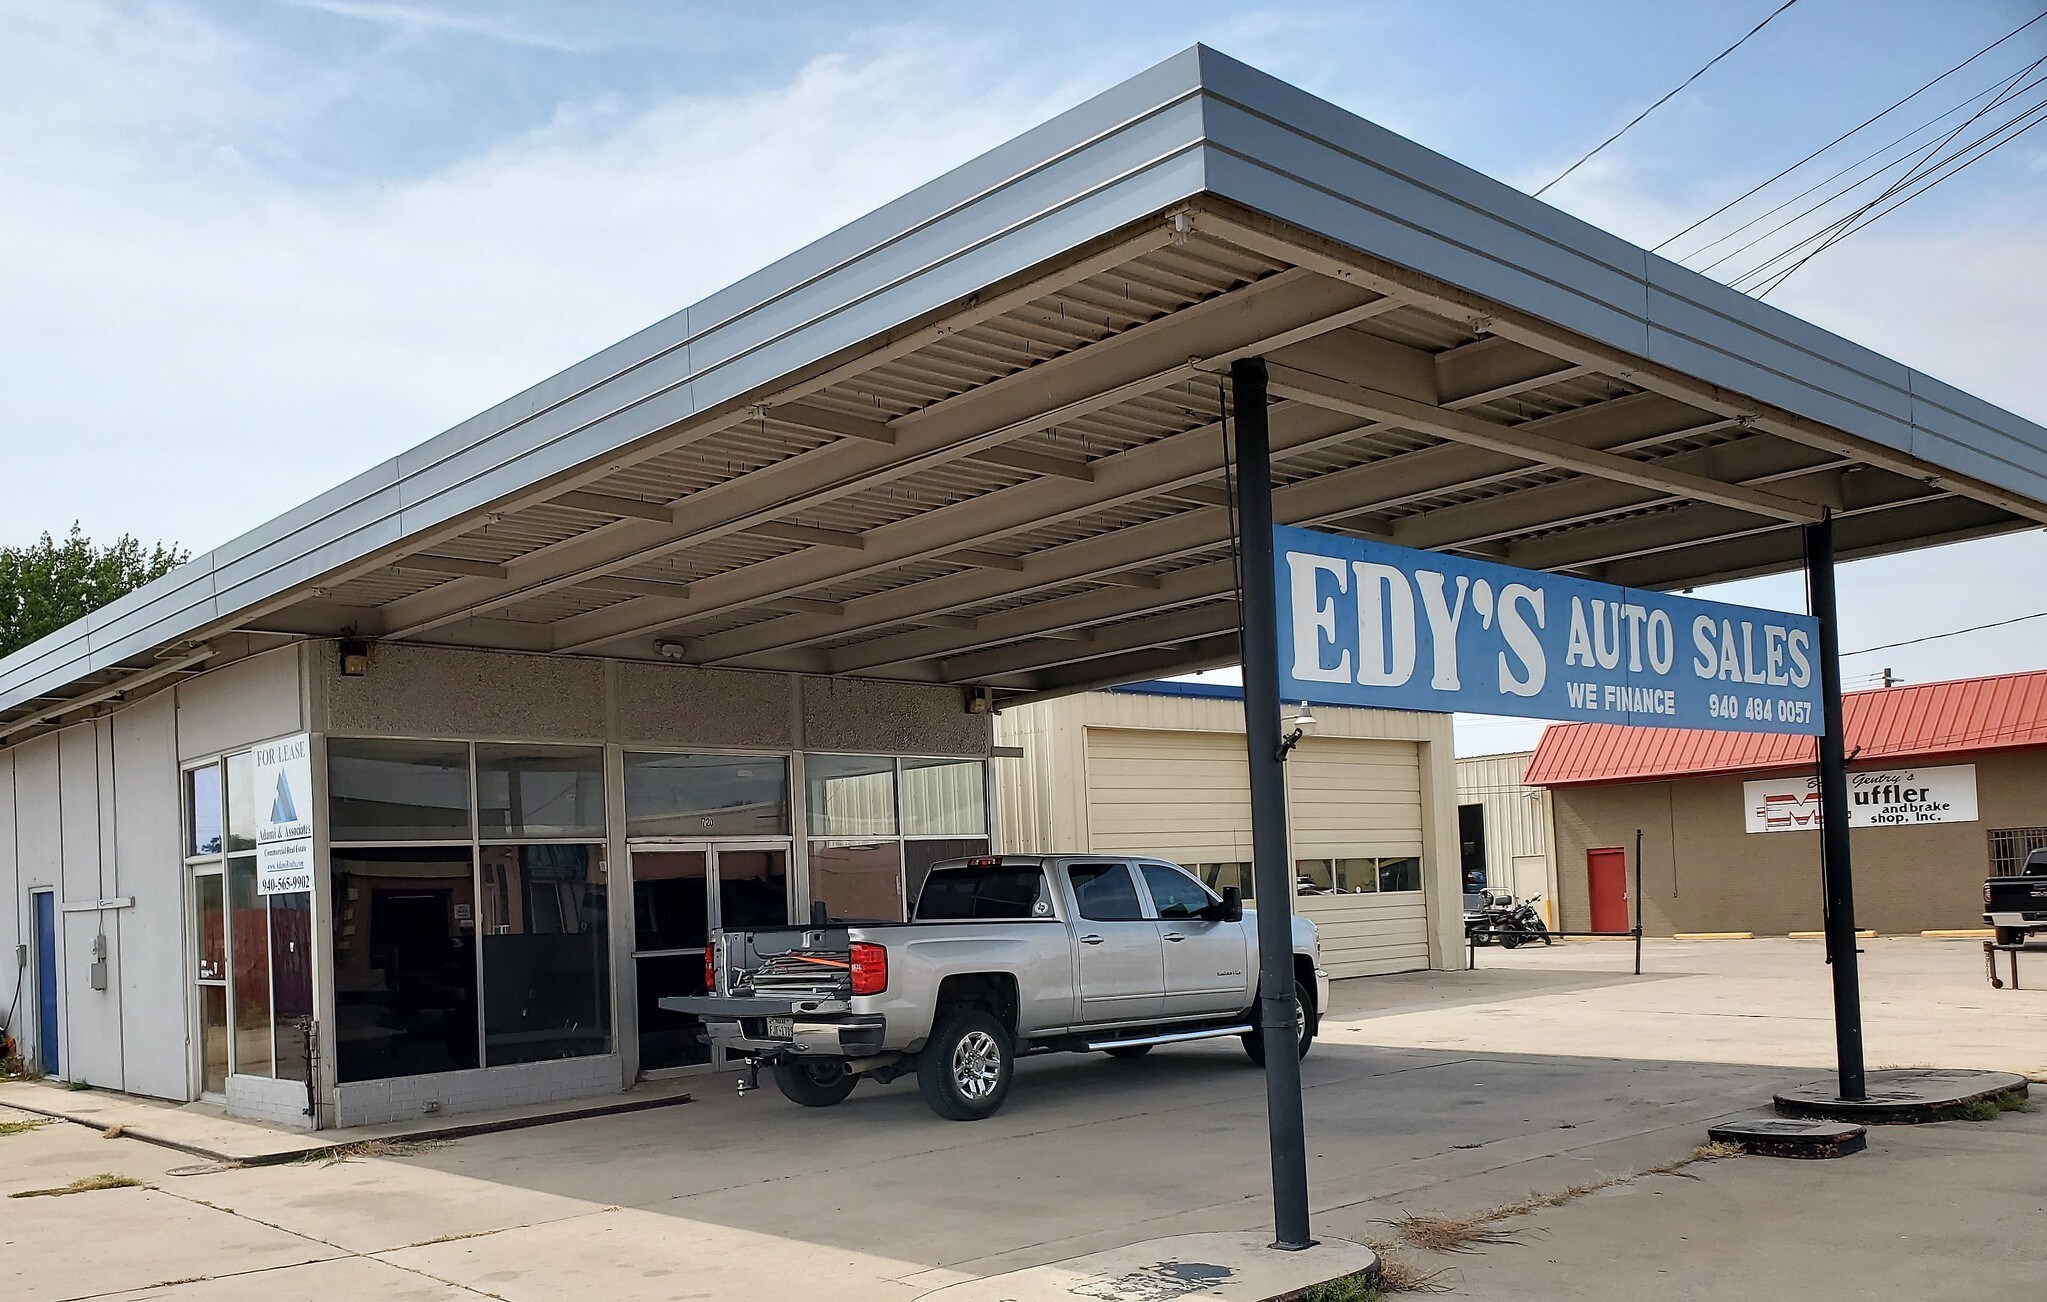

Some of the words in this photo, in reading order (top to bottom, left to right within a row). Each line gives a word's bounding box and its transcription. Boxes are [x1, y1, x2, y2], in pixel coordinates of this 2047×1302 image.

[1286, 551, 1547, 697] EDY'S
[1566, 596, 1674, 675] AUTO
[1692, 615, 1811, 689] SALES
[1566, 682, 1597, 710] WE
[1604, 685, 1675, 715] FINANCE
[1709, 694, 1738, 719] 940
[1745, 698, 1772, 722] 484
[1778, 700, 1812, 724] 0057
[257, 748, 276, 767] FOR
[278, 741, 306, 763] LEASE
[1852, 770, 1915, 788] Gentry's
[1882, 803, 1907, 813] and
[1909, 802, 1950, 812] brake
[1916, 811, 1942, 821] Inc.
[278, 826, 283, 839] &
[285, 823, 311, 838] Associates
[264, 847, 286, 857] Commercial
[287, 846, 295, 854] Real
[296, 845, 307, 853] Estate
[262, 875, 310, 891] 940-565-9902
